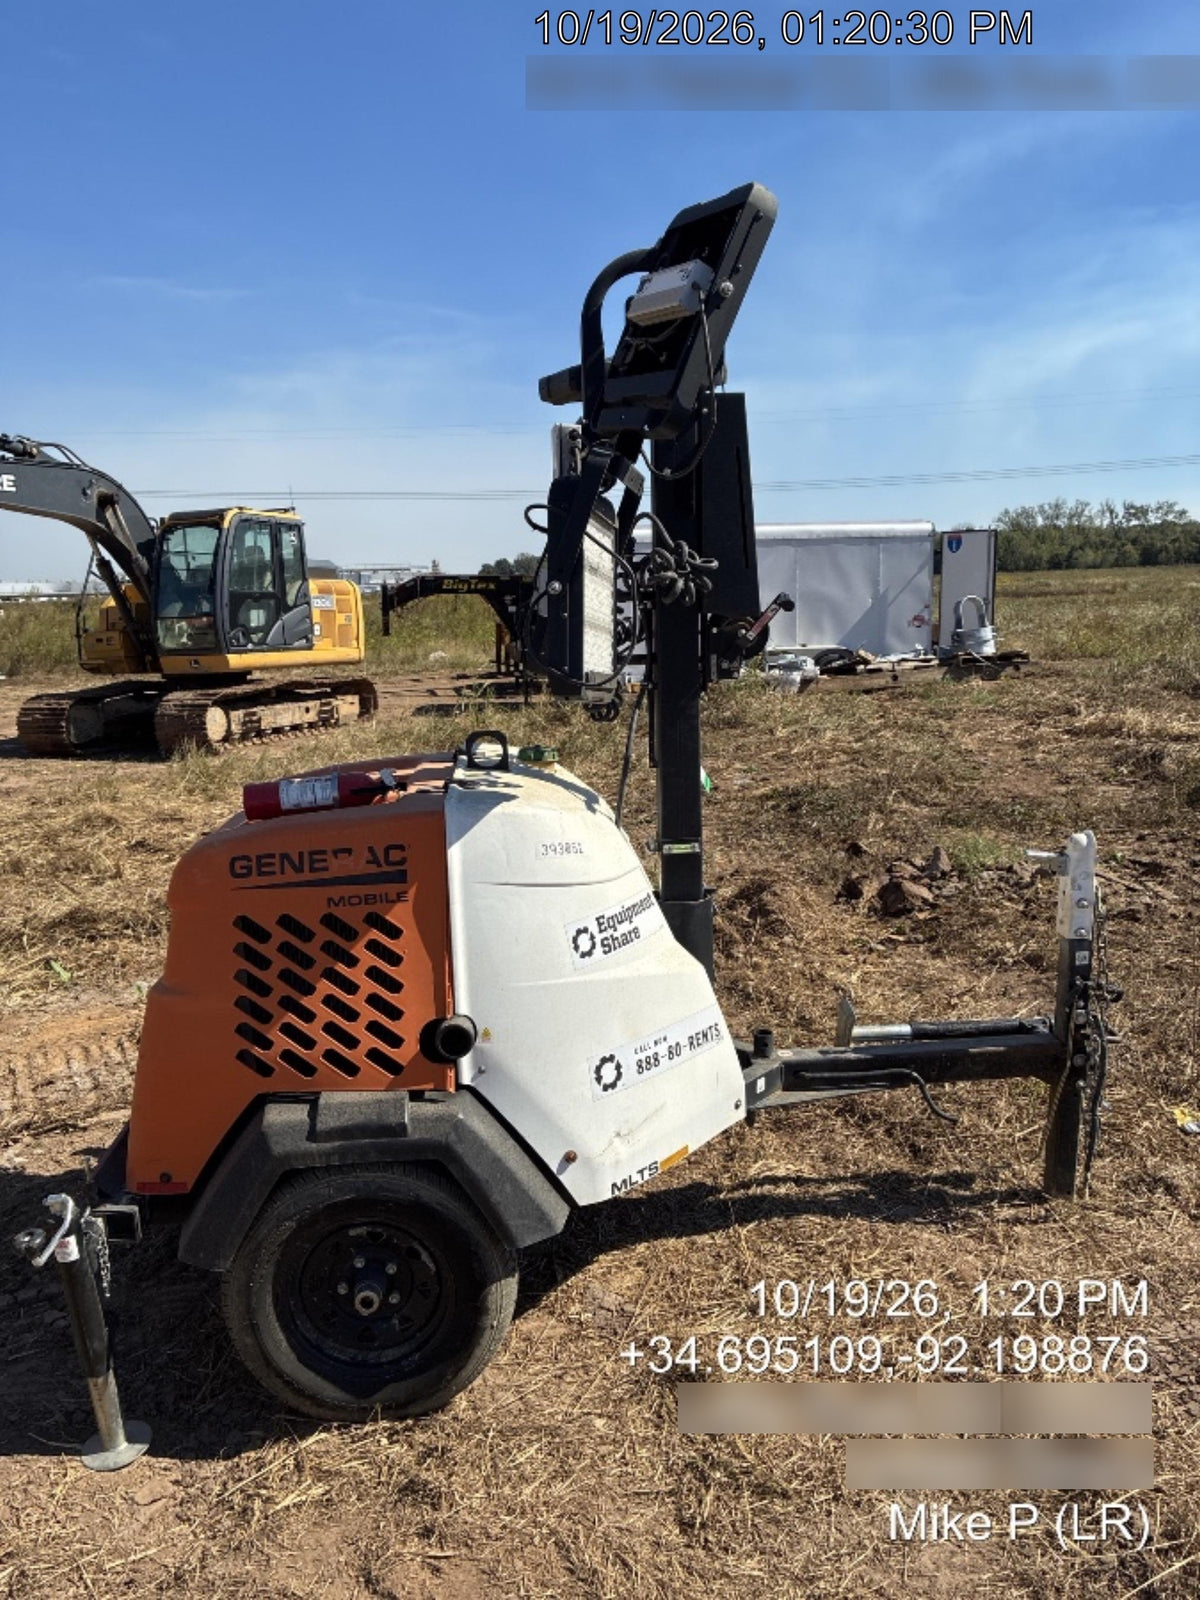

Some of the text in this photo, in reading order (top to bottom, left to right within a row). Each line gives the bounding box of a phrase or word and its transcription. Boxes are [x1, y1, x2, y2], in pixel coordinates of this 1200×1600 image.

[327, 890, 409, 908] MOBILE
[595, 892, 655, 934] Equipment
[600, 926, 641, 955] Share
[611, 1160, 659, 1195] MLTS
